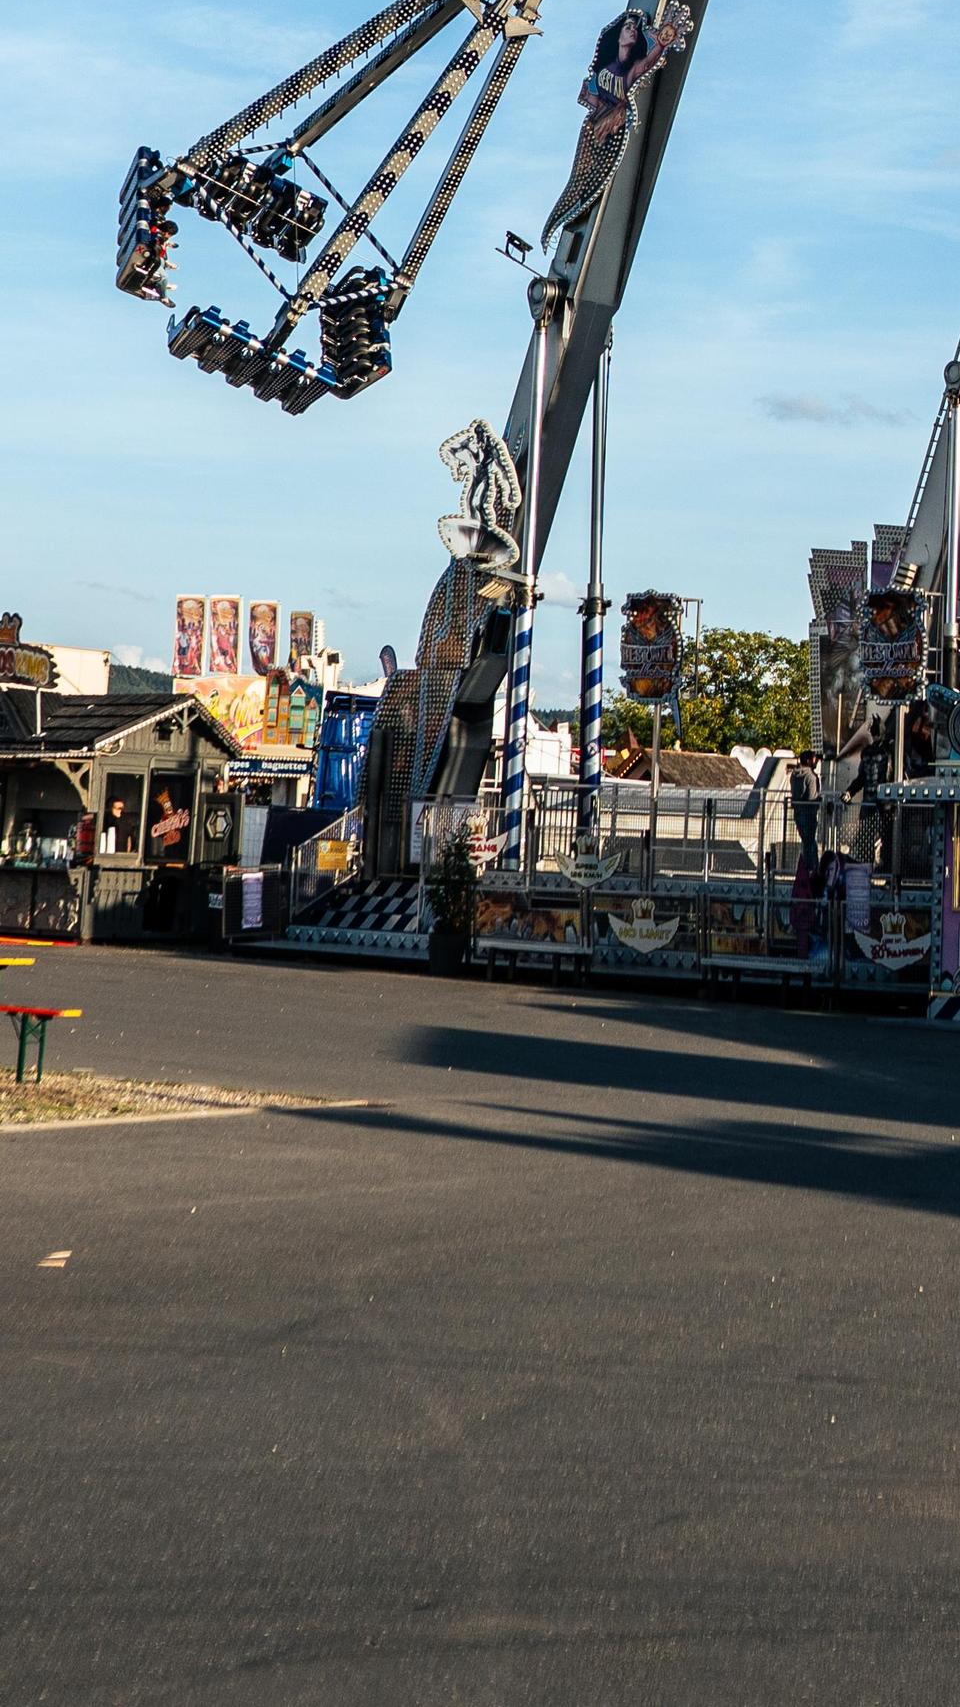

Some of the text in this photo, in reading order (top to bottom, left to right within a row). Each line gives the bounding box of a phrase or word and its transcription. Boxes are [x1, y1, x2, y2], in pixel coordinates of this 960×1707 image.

[261, 761, 308, 771] baguettes
[618, 926, 673, 940] NO LIMIT
